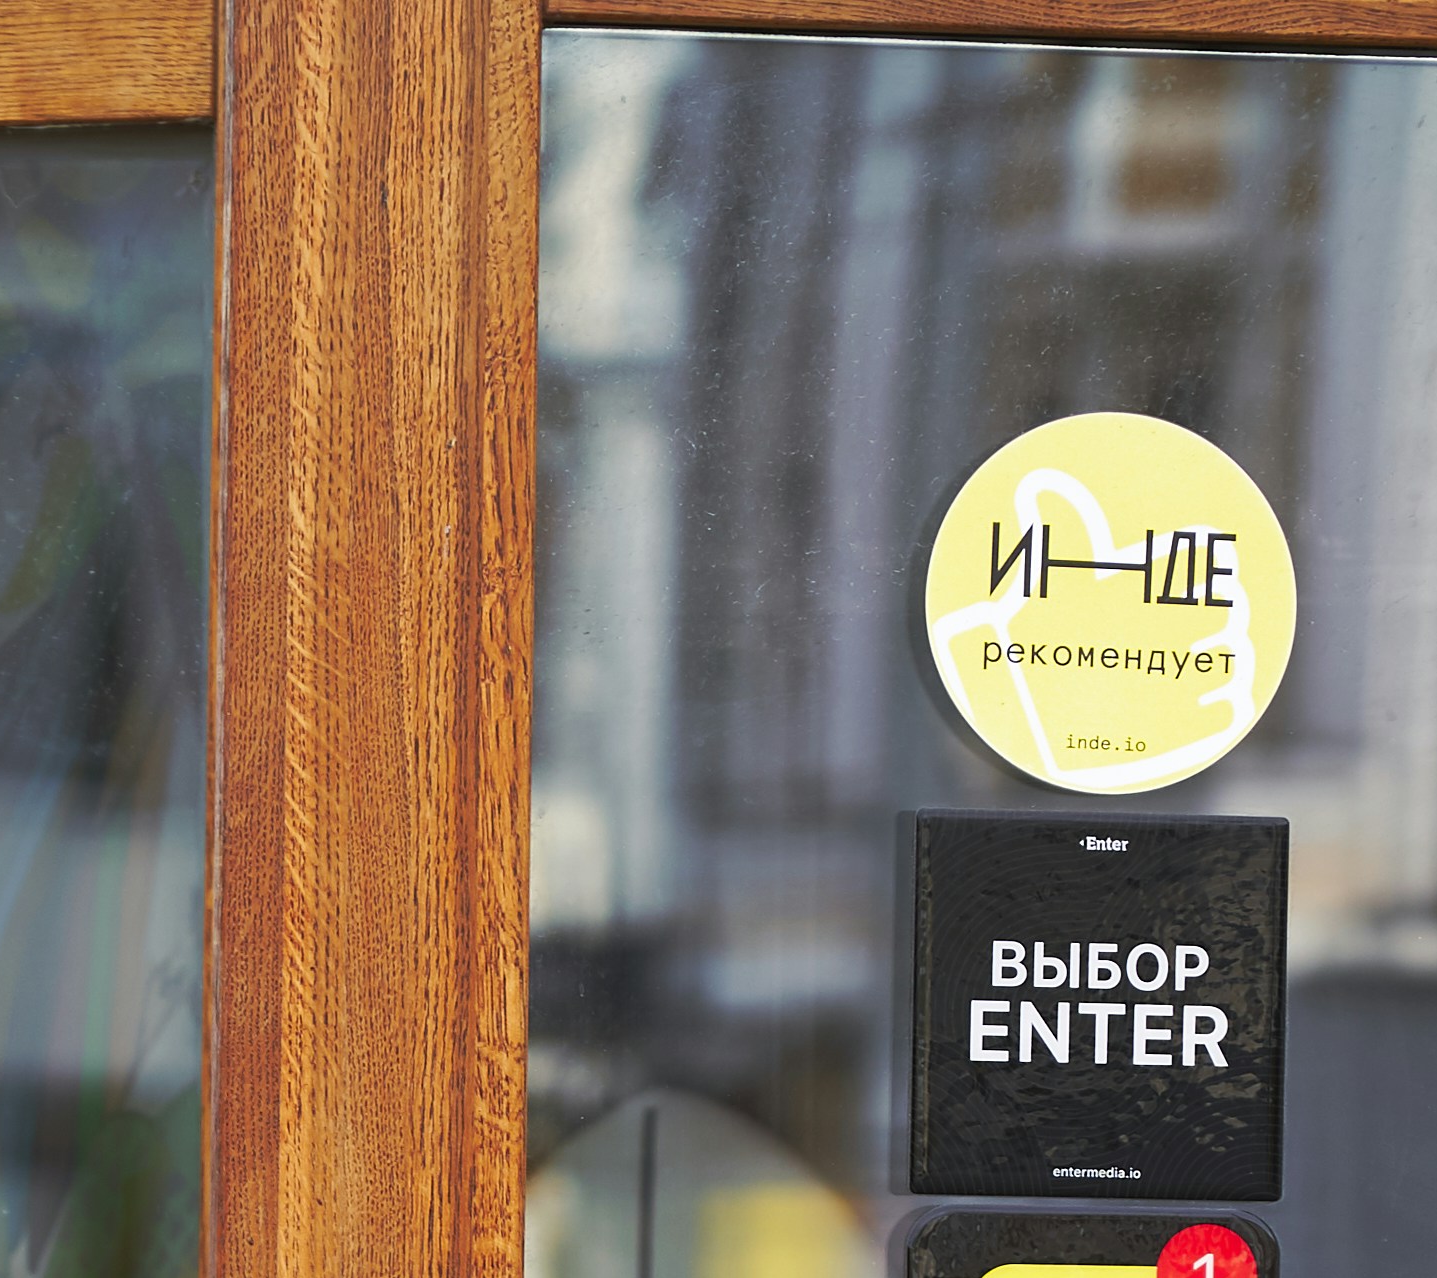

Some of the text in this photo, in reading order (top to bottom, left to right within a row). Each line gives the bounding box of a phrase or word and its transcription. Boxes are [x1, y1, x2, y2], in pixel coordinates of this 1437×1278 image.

[989, 520, 1237, 609] ИНДЕ
[982, 637, 1237, 680] рекомендует
[1065, 734, 1148, 754] inde.io
[1085, 835, 1130, 853] Enter
[991, 939, 1210, 992] ВЫБОР
[969, 999, 1230, 1067] ENTER
[1052, 1165, 1143, 1181] entermedia.io
